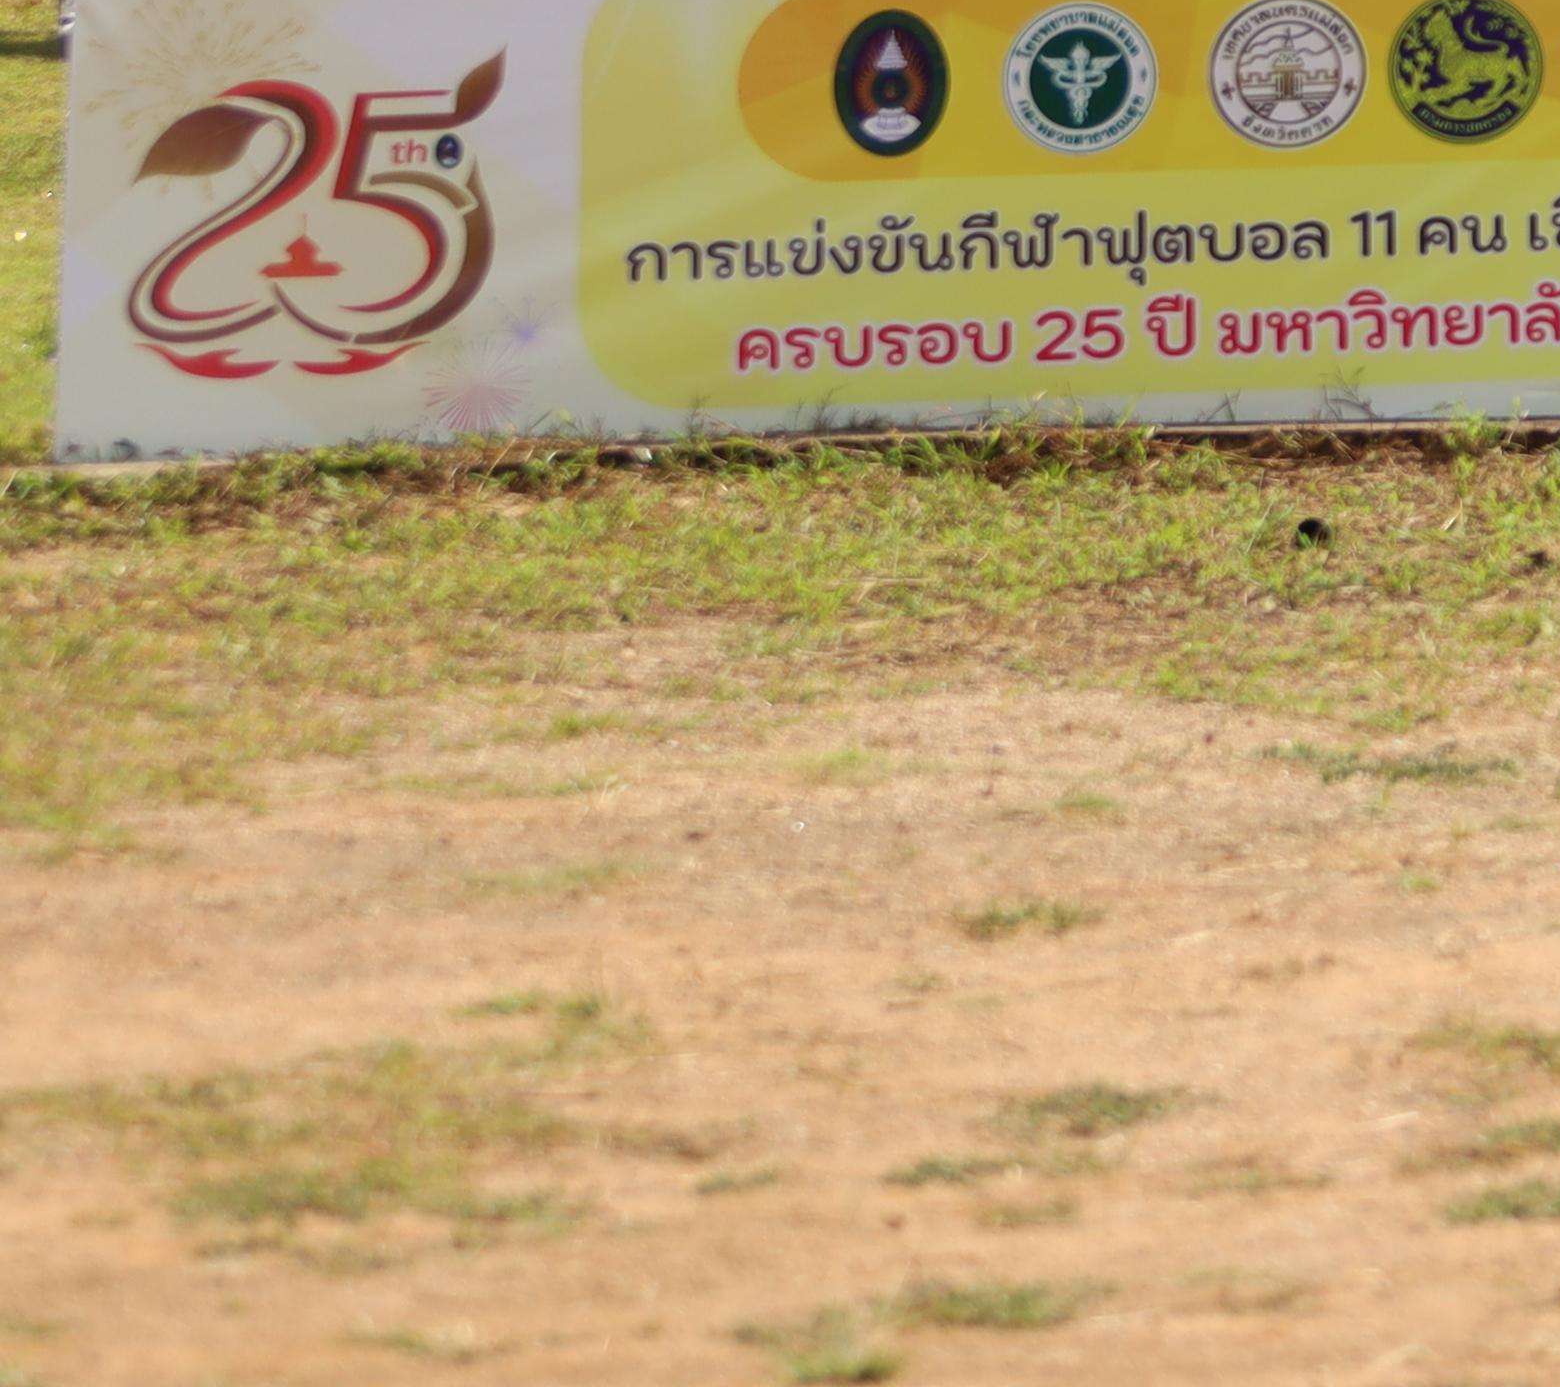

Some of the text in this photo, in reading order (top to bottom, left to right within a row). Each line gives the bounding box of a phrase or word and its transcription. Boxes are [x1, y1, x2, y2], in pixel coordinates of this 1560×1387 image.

[390, 138, 430, 165] th
[627, 209, 1331, 287] การแข่งขันกีฬาฟุตบอล
[1350, 210, 1397, 258] 11
[1418, 211, 1507, 256] คน
[736, 320, 1013, 373] ครบรอบ
[1034, 308, 1125, 362] 25
[1145, 295, 1198, 359] ปี
